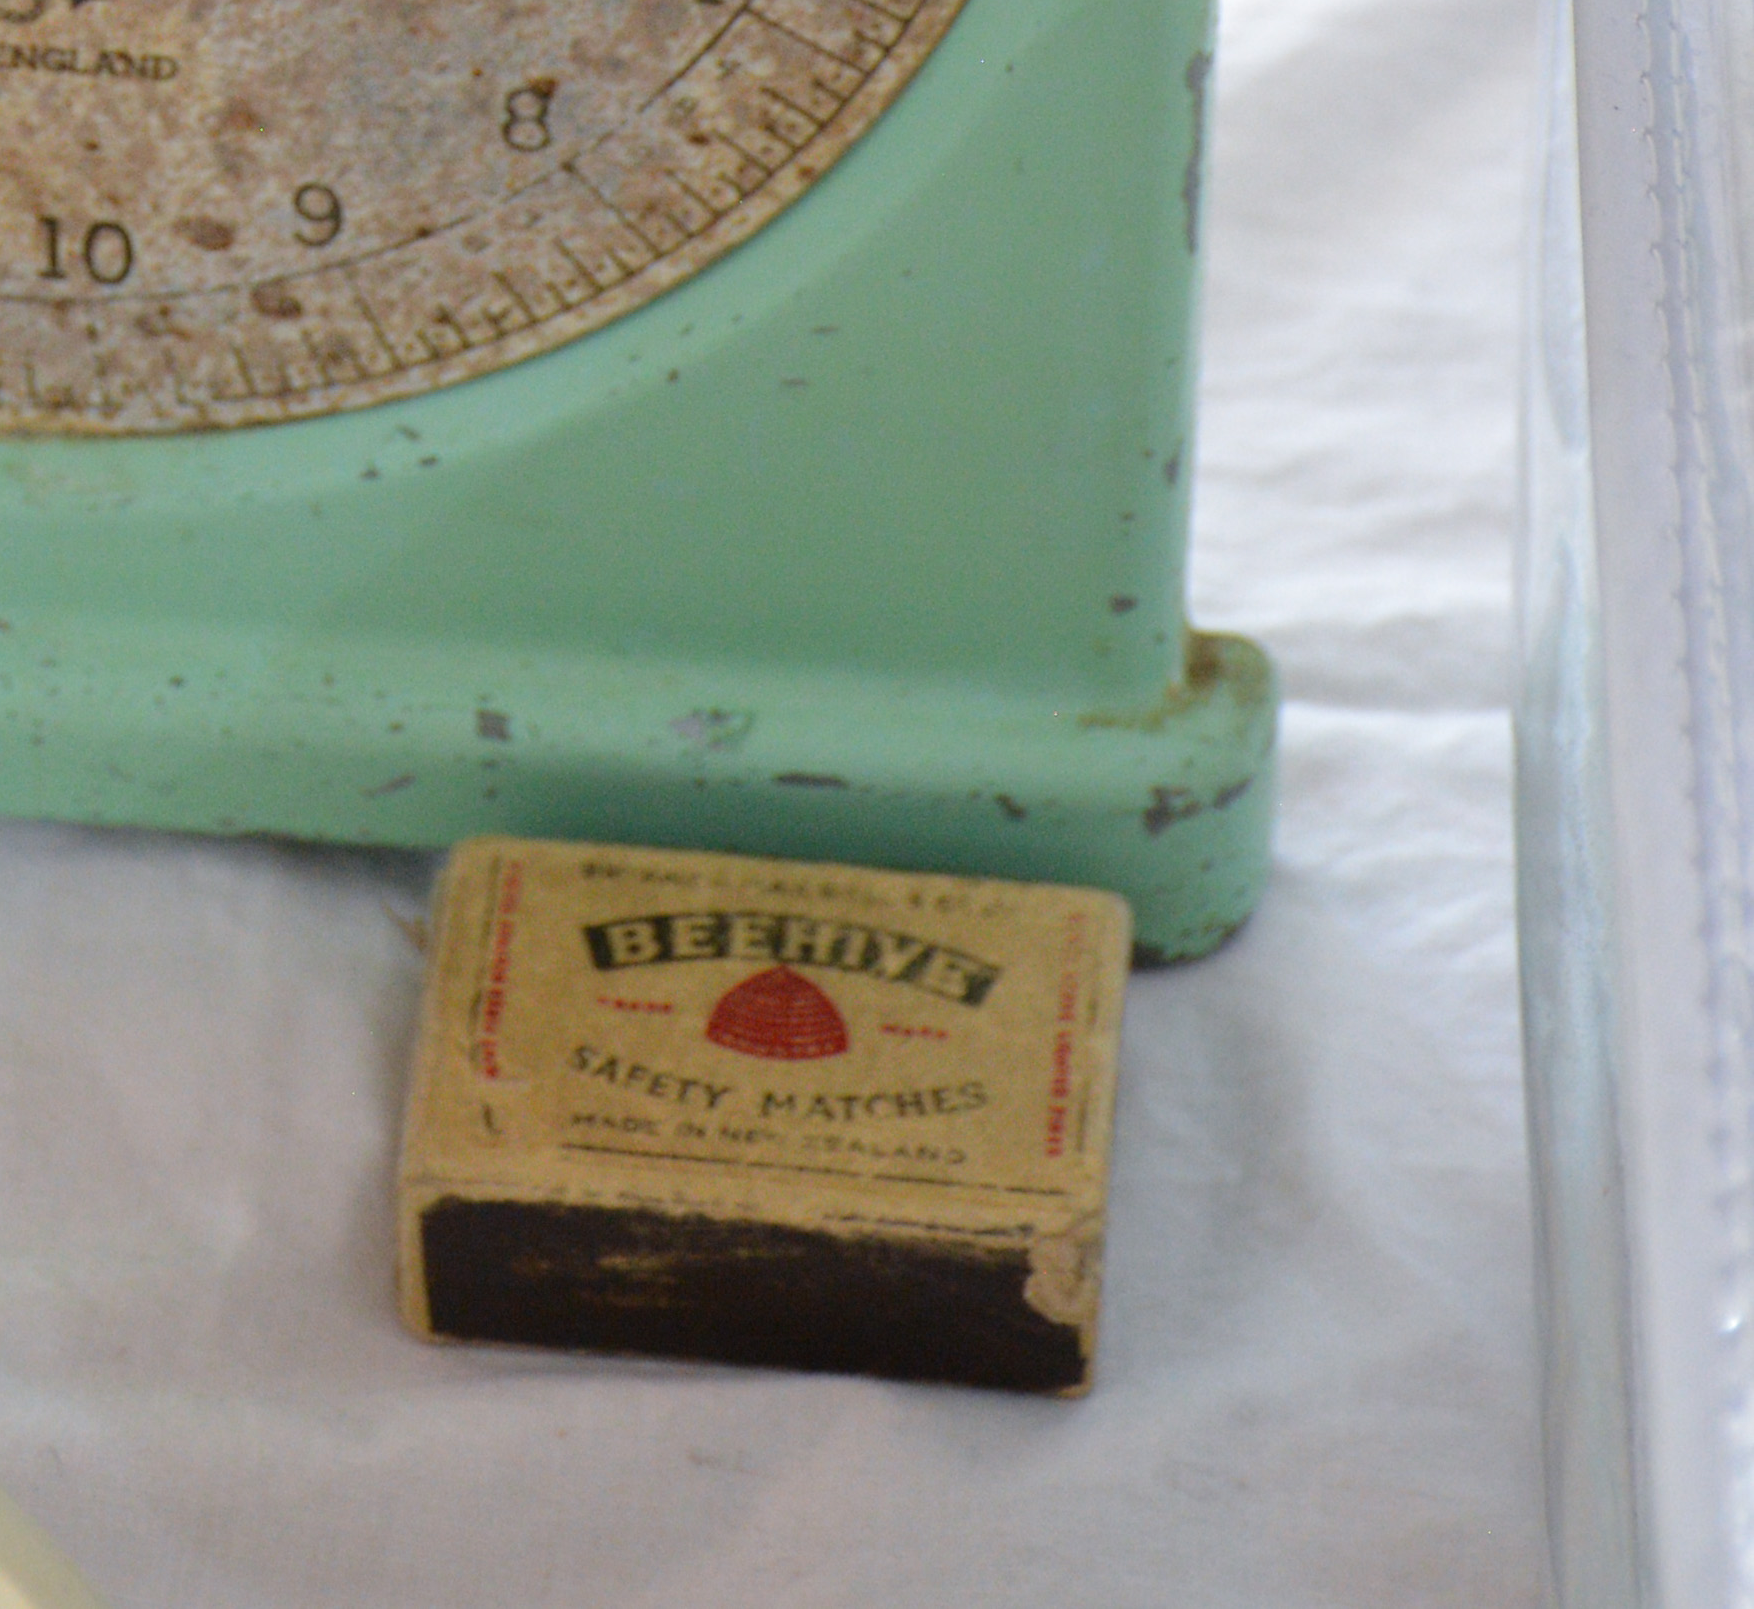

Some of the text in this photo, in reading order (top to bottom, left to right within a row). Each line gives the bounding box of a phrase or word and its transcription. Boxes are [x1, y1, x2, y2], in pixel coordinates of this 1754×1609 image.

[501, 87, 554, 154] 8
[36, 214, 135, 285] 10
[292, 182, 343, 248] 9
[604, 913, 974, 1000] BEEHIVE
[569, 1043, 989, 1124] SAFETY MATCHES
[570, 1110, 661, 1138] MADE
[801, 1134, 968, 1166] ZEALAND
